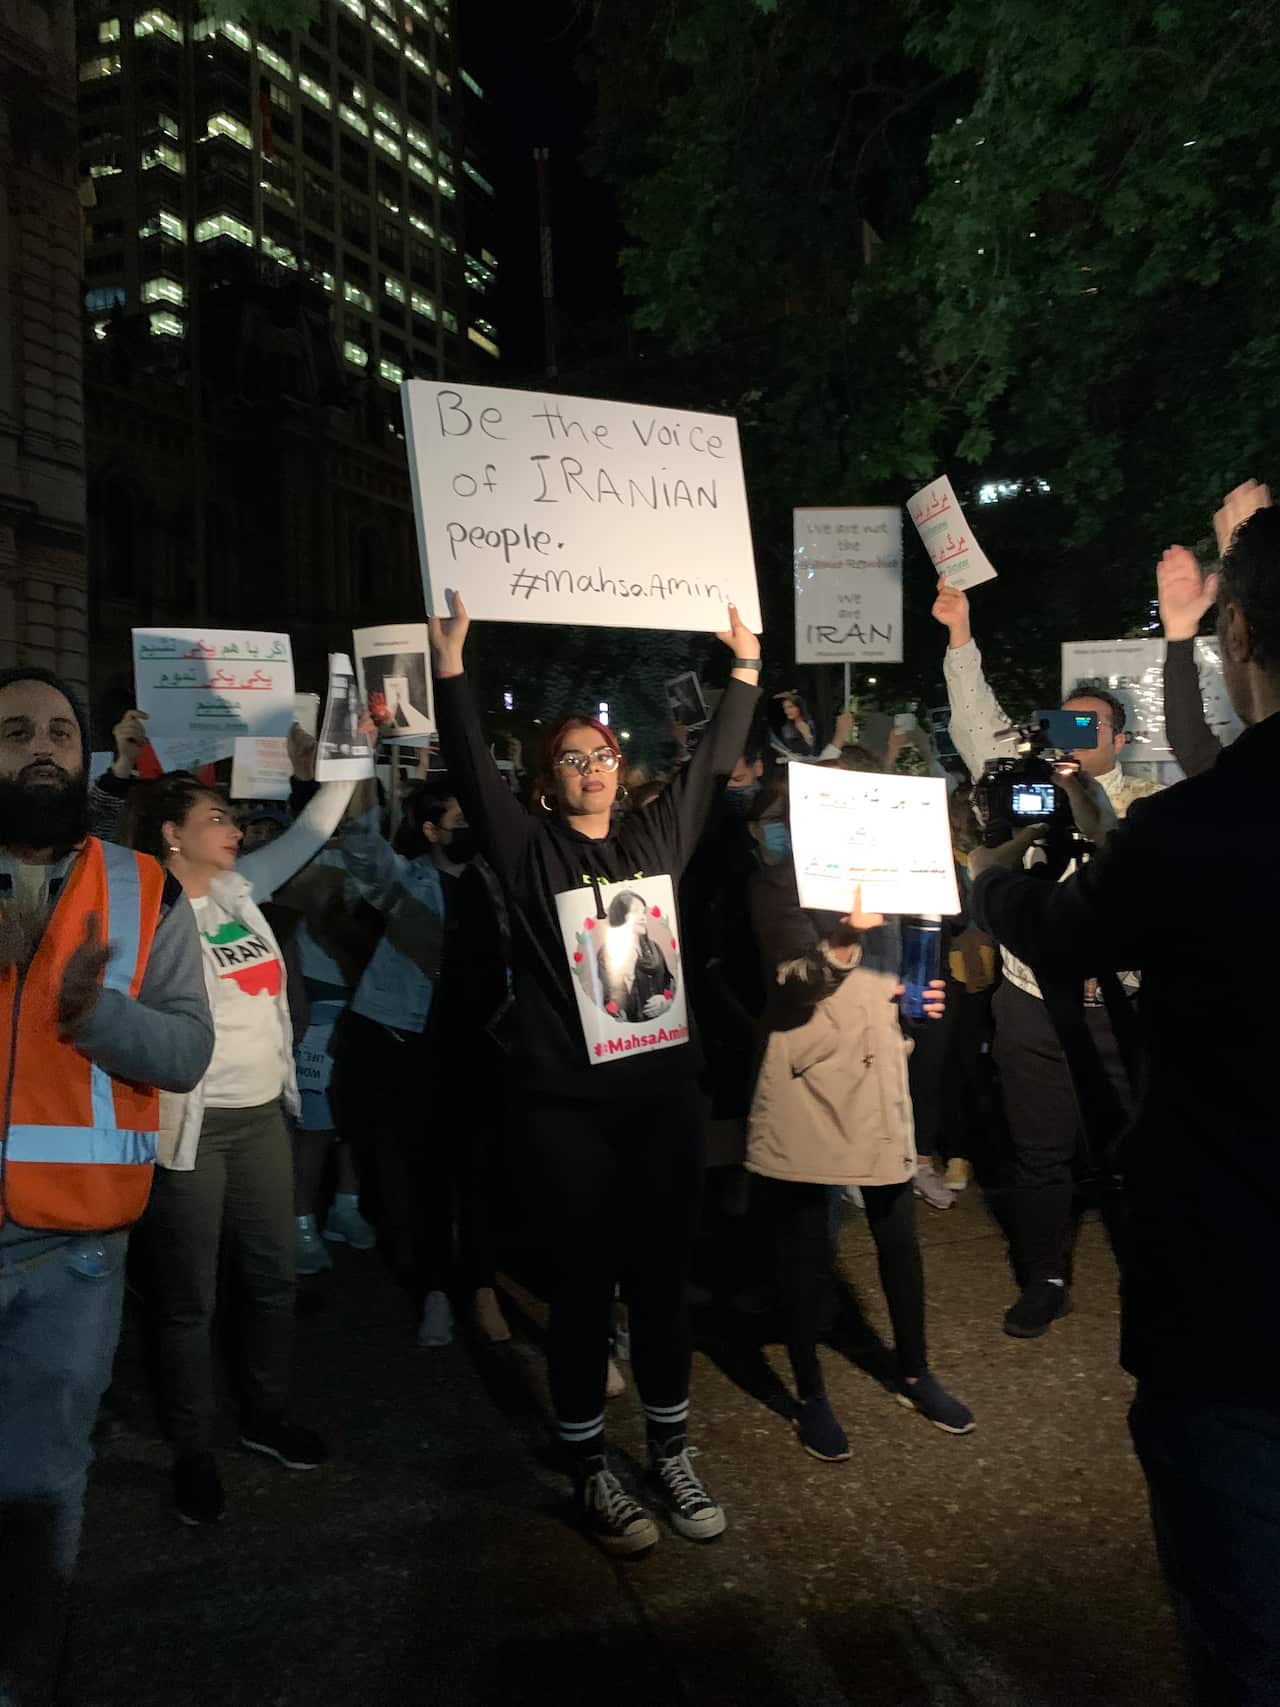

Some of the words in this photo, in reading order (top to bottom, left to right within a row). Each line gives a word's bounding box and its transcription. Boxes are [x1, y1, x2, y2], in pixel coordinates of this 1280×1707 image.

[436, 390, 507, 440] Be
[531, 402, 614, 450] the
[452, 464, 497, 498] of
[446, 521, 566, 563] people.
[807, 624, 893, 645] IRAN
[211, 936, 270, 967] IRAN
